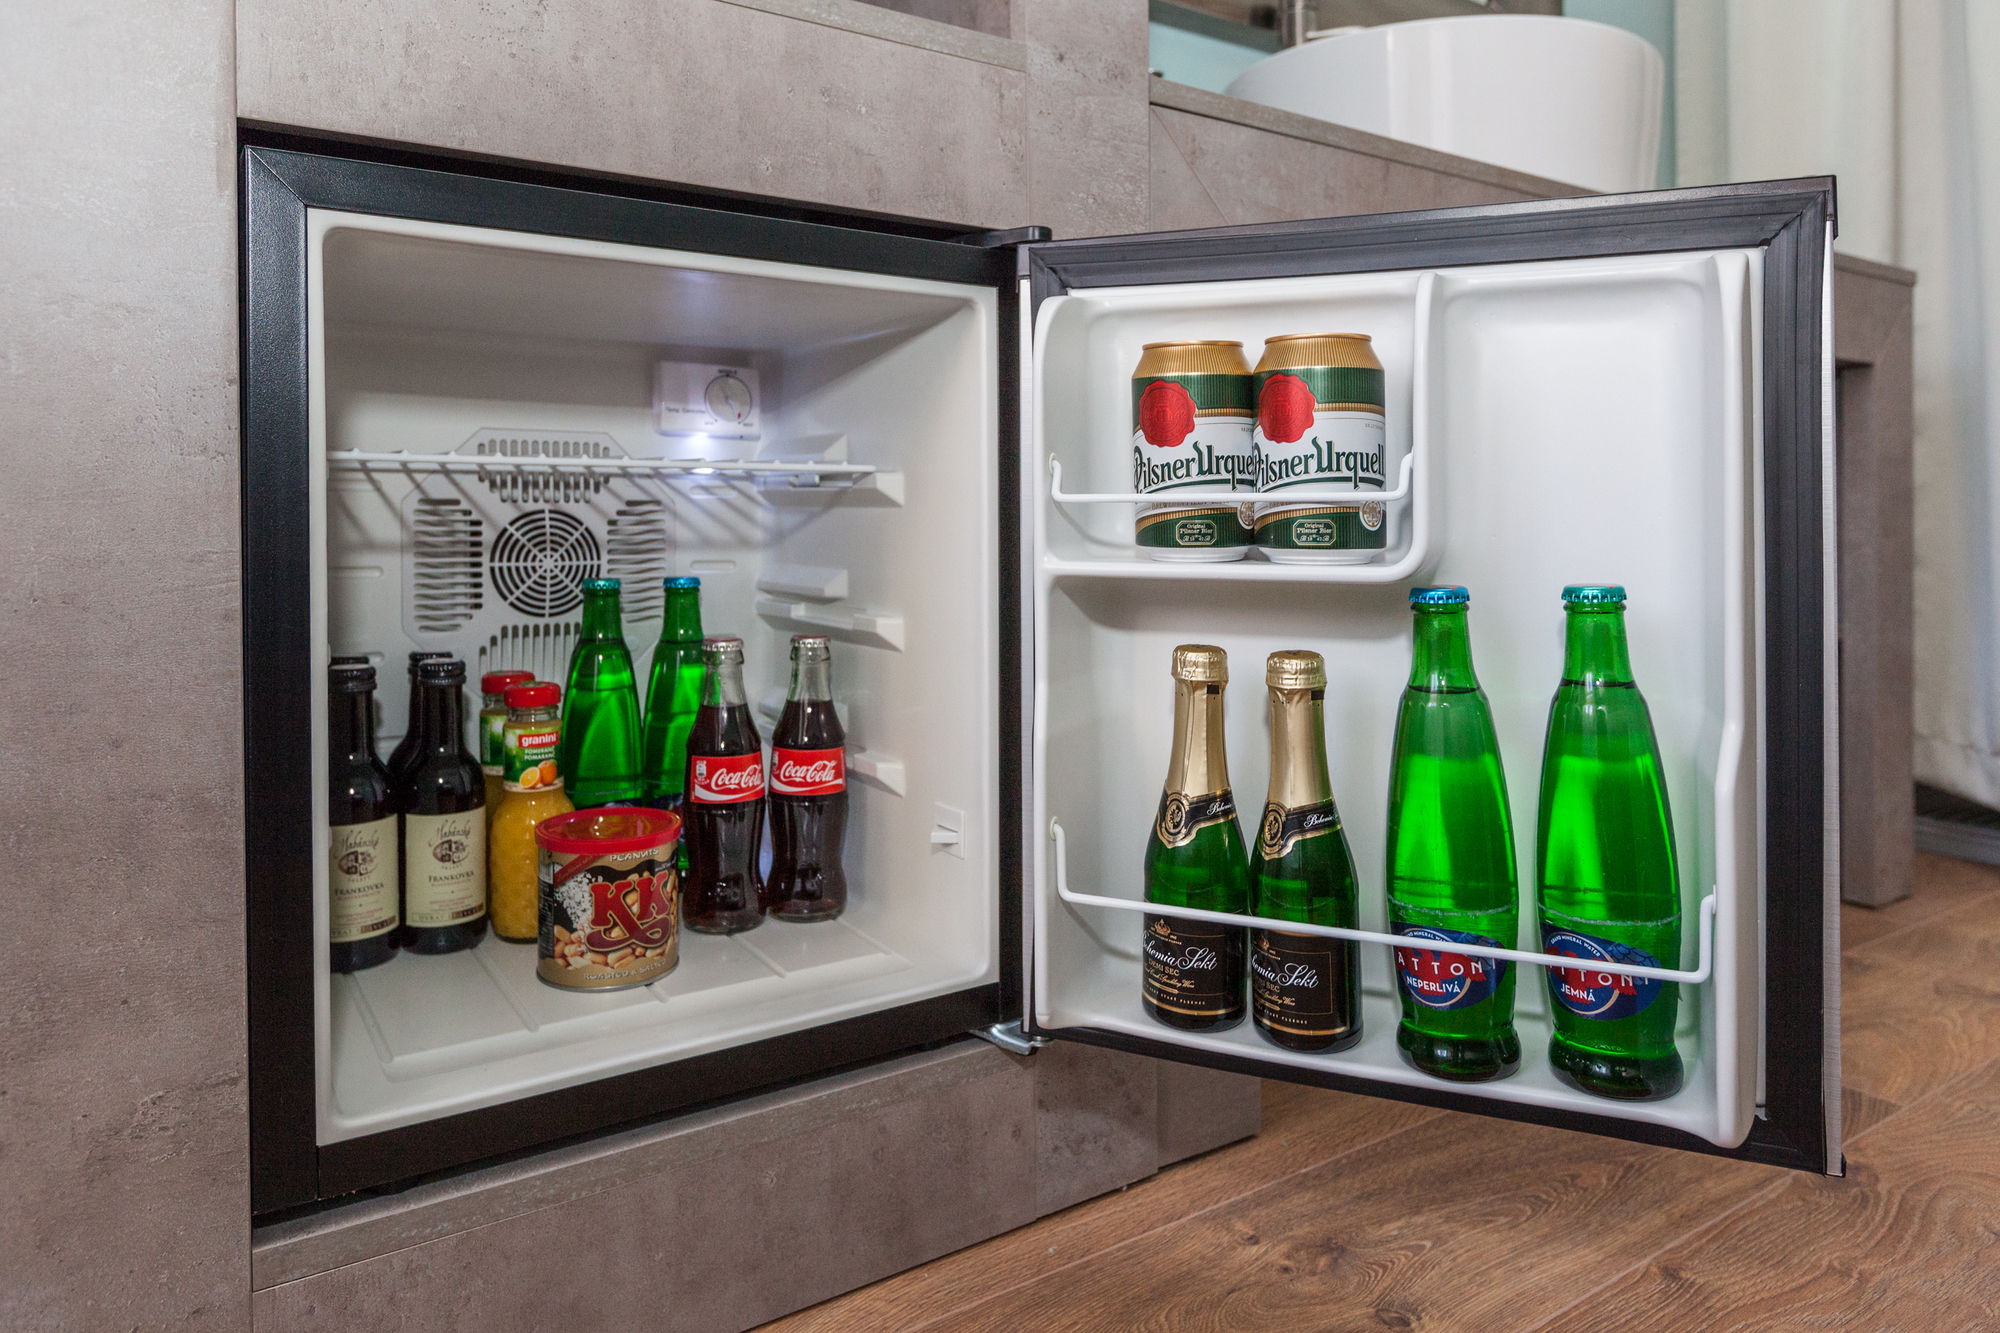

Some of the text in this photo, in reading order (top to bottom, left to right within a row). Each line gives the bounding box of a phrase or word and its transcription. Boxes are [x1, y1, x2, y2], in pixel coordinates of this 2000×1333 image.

[1133, 445, 1196, 494] Pilsner
[1253, 436, 1385, 494] Pilsner Urquell
[521, 733, 557, 747] granini
[710, 764, 763, 791] Coca-Cola
[780, 759, 838, 783] Coca-Cola
[609, 848, 660, 862] PEANUTS
[428, 869, 475, 883] FRANKOVKA
[1561, 935, 1582, 945] MINERAL
[1583, 942, 1601, 957] WATER
[1177, 946, 1218, 970] Sekt
[1398, 951, 1496, 976] ATTONI
[1164, 966, 1180, 977] SEC
[1278, 962, 1320, 988] Sekt
[1406, 975, 1461, 993] NEPERLIVÁ
[1561, 983, 1596, 1002] JEMNÁ
